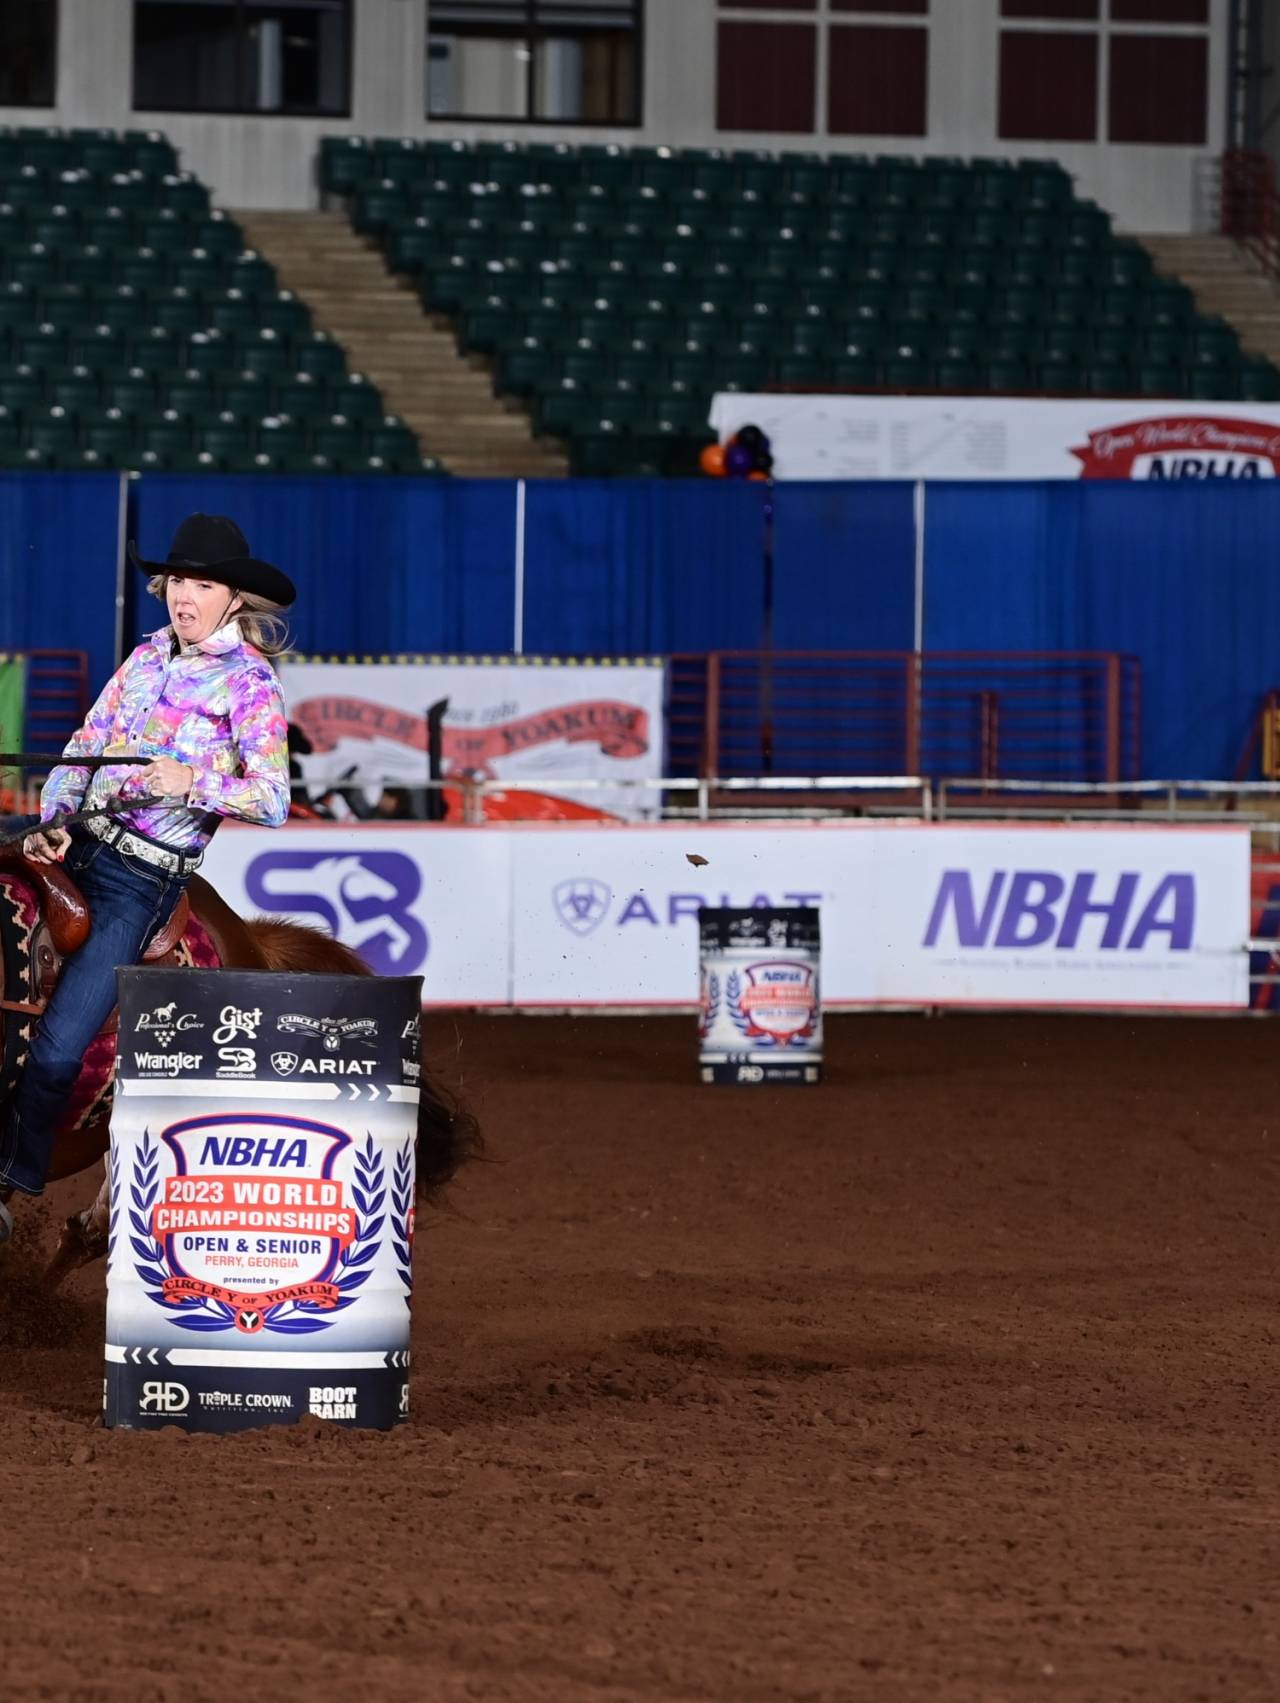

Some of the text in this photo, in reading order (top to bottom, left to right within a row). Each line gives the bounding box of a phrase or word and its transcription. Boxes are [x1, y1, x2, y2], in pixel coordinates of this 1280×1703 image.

[922, 869, 1197, 951] NBHA
[176, 1012, 205, 1031] Choice
[212, 1005, 263, 1045] Gist
[280, 1015, 320, 1029] CIRCLE
[340, 1020, 376, 1033] YOAKUM
[134, 1051, 203, 1077] Wrangler
[299, 1058, 377, 1075] ARIAT
[199, 1136, 309, 1168] NBHA
[170, 1181, 337, 1207] 2023 WORLD
[157, 1208, 350, 1234] CHAMPIONSHIPS
[183, 1235, 322, 1255] OPEN & SENIOR
[204, 1254, 300, 1269] PERRY, GEORGIA
[223, 1275, 280, 1286] presented by
[164, 1279, 334, 1305] CIRCLE Y OF YOAKUM
[198, 1390, 292, 1408] TRIPLE CROWN
[308, 1386, 357, 1403] BOOT
[308, 1403, 357, 1419] BARN
